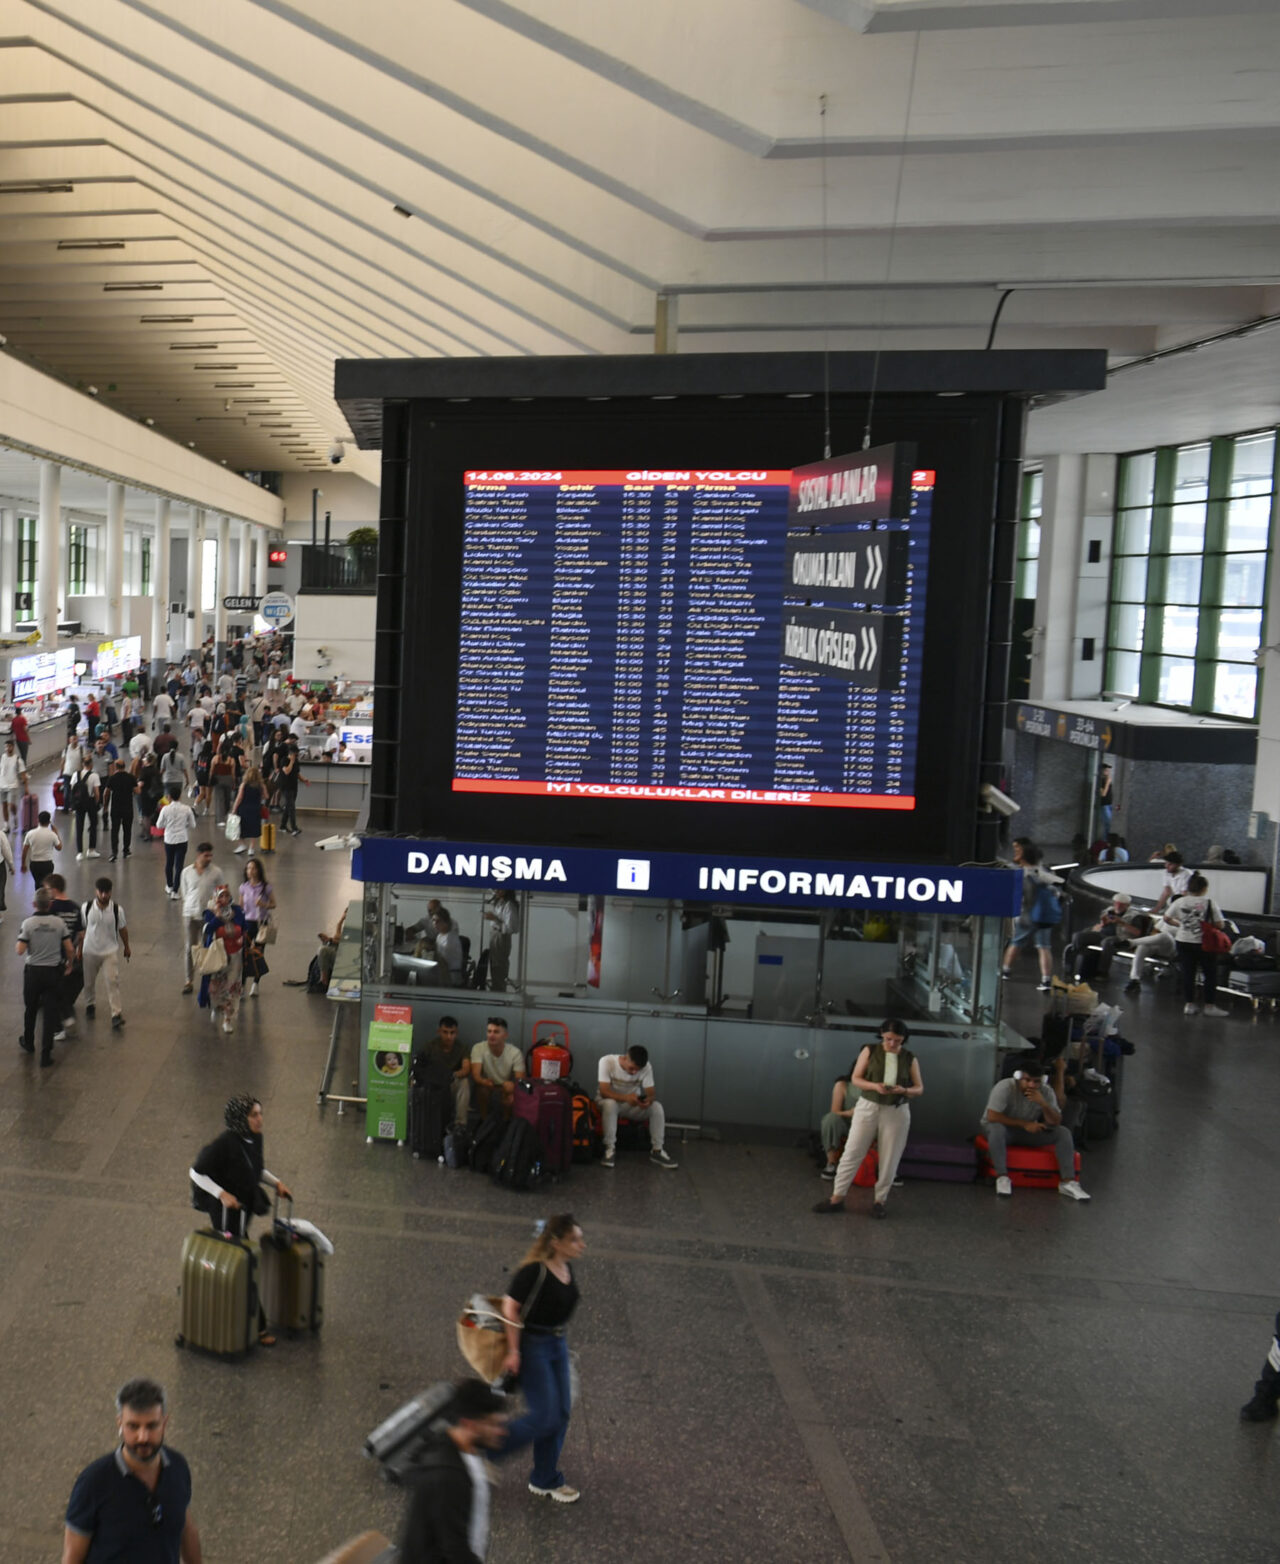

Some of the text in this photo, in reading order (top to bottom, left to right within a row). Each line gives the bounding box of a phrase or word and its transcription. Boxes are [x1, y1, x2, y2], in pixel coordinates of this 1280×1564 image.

[466, 472, 562, 480] 14.06.2024
[625, 470, 690, 481] GİDEN
[694, 472, 767, 481] YOLCU
[792, 551, 825, 586] OKUMA
[225, 598, 252, 608] GELEN
[784, 615, 857, 671] KİRALIK OFİSLER
[546, 782, 811, 802] İYİ YOLCULUKLAR DİLERİZ
[407, 851, 568, 882] DANIŞMA
[698, 866, 965, 903] INFORMATION
